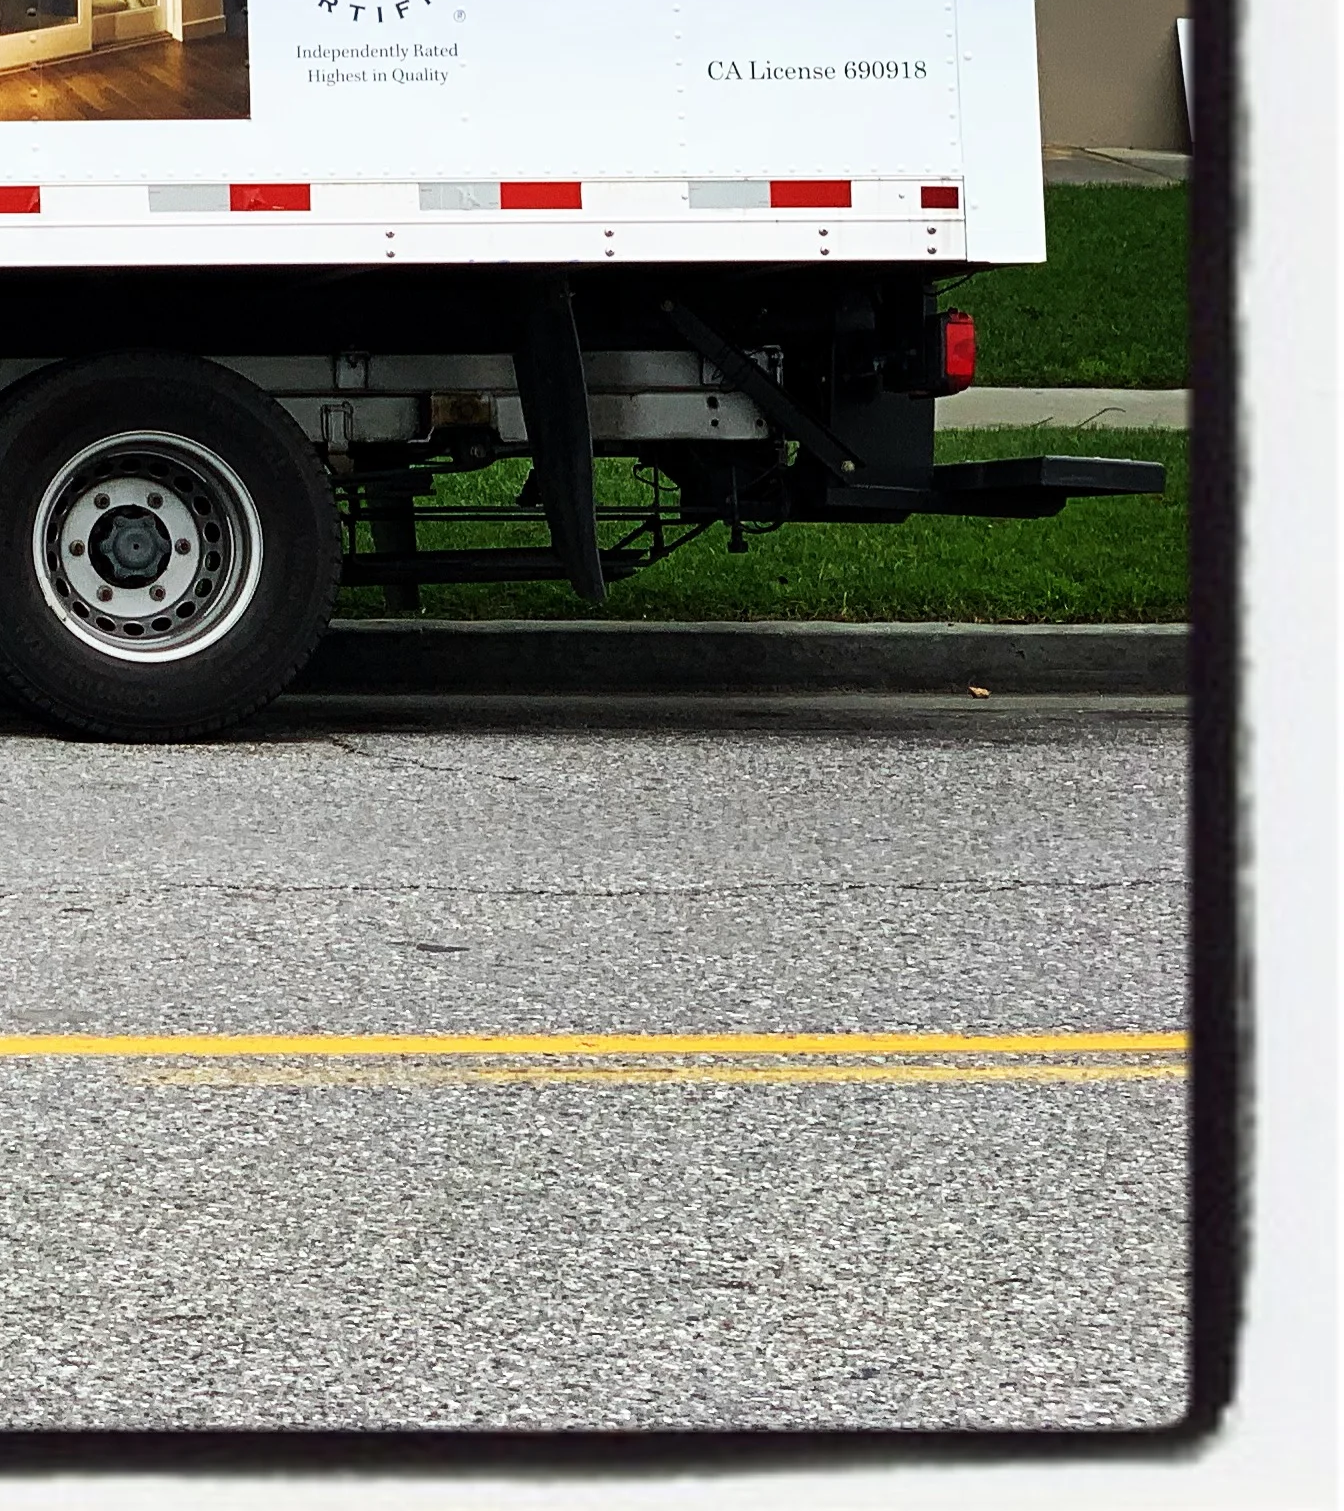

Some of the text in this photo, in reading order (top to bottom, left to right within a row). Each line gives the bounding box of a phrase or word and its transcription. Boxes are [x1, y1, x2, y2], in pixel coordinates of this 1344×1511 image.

[296, 42, 458, 62] Independently Rated
[308, 68, 449, 86] Highest in Quality
[707, 58, 928, 81] CA License 690918
